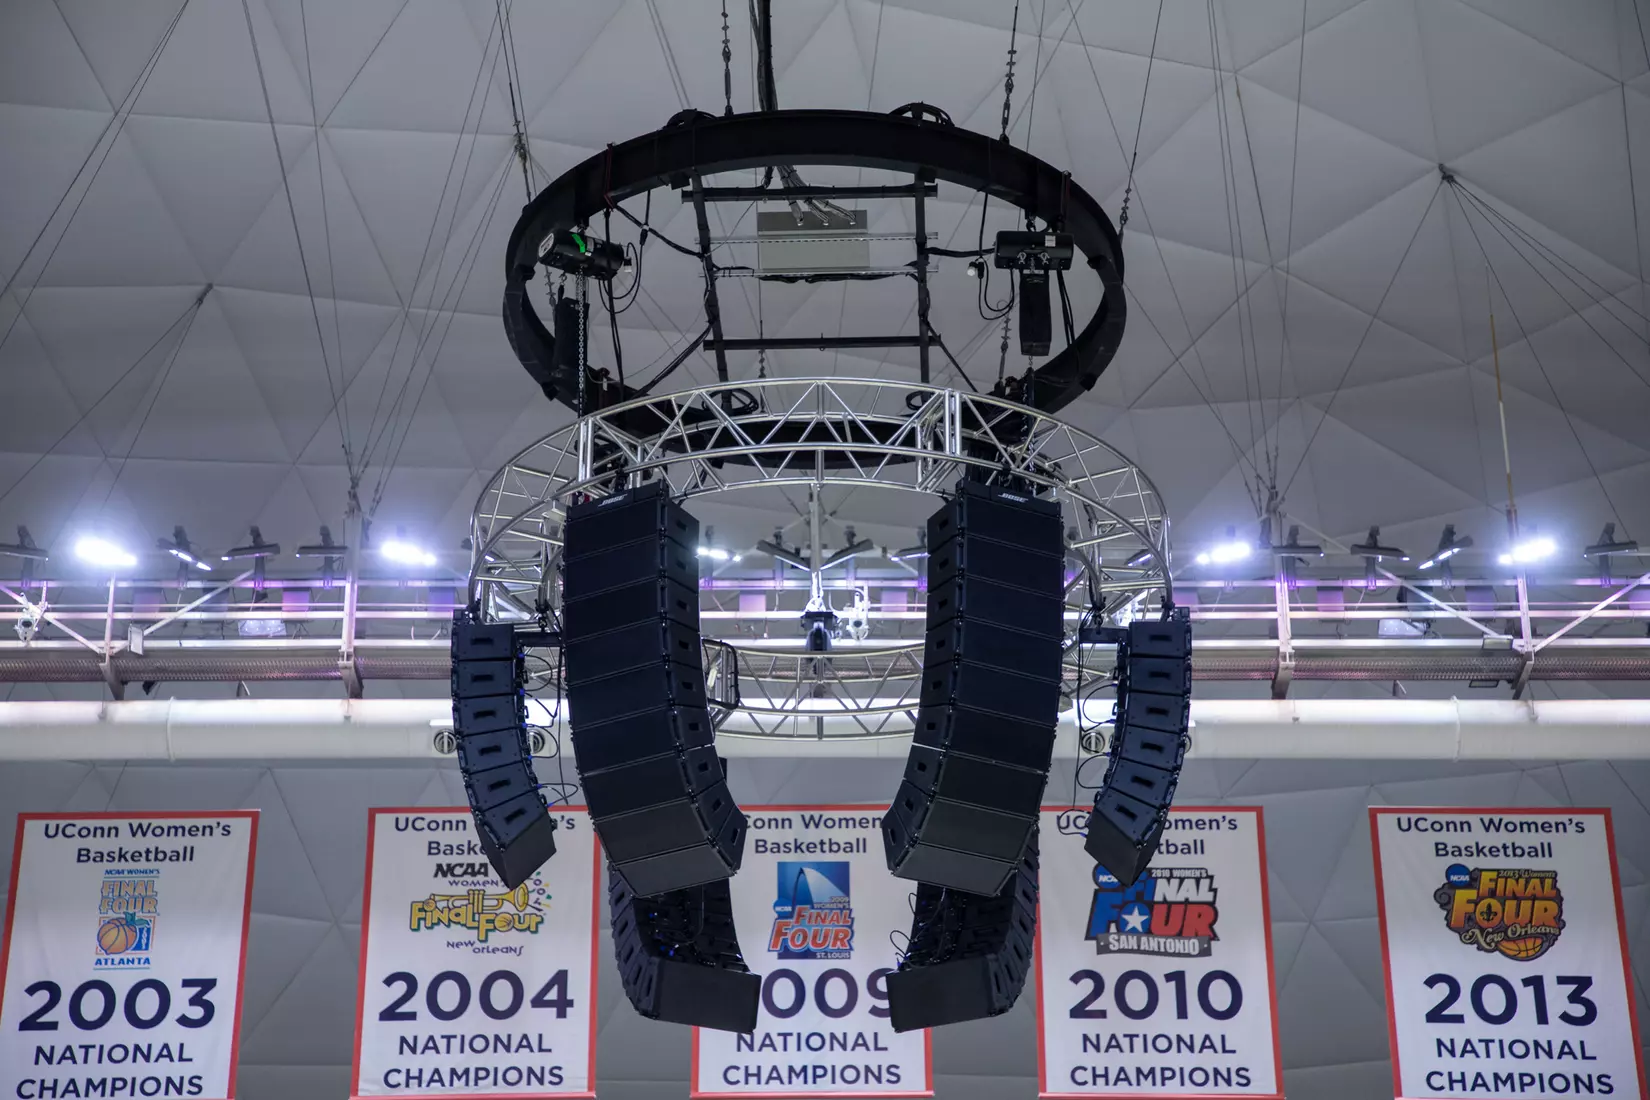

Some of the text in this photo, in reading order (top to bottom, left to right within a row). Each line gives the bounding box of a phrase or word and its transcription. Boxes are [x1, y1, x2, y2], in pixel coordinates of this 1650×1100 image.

[44, 820, 231, 839] UConn Women's
[395, 816, 467, 833] UConn
[801, 814, 882, 830] Women
[1397, 816, 1586, 834] UConn Women's
[76, 846, 195, 864] Basketball
[754, 837, 867, 855] Basketball
[1433, 841, 1553, 859] Basketball
[433, 862, 489, 878] NCAA
[1152, 868, 1207, 878] 2010 WOMEN'S
[1449, 874, 1470, 882] NCAA
[1498, 869, 1519, 878] 2013
[101, 879, 158, 897] FINAL
[1479, 870, 1557, 898] FINAL
[99, 897, 158, 915] FOUR
[794, 905, 851, 926] FINAL
[1450, 889, 1559, 928] FOUR
[770, 919, 851, 950] FOUR
[1108, 934, 1200, 955] SAN ANTONIO
[1461, 923, 1560, 950] New Orleans
[95, 957, 151, 967] ATLANTA
[379, 969, 574, 1022] 2004
[762, 968, 896, 1019] 009
[1069, 969, 1243, 1020] 2010
[1423, 973, 1598, 1027] 2013
[19, 978, 218, 1032] 2003
[398, 1033, 552, 1056] NATIONAL
[736, 1032, 889, 1053] NATIONAL
[1082, 1033, 1237, 1055] NATIONAL
[1436, 1037, 1597, 1061] NATIONAL
[34, 1043, 193, 1066] NATIONAL
[383, 1065, 564, 1089] CHAMPIONS
[722, 1064, 901, 1086] CHAMPIONS
[1070, 1066, 1251, 1087] CHAMPIONS
[1425, 1071, 1615, 1095] CHAMPIONS
[16, 1075, 204, 1100] CHAMPIONS
